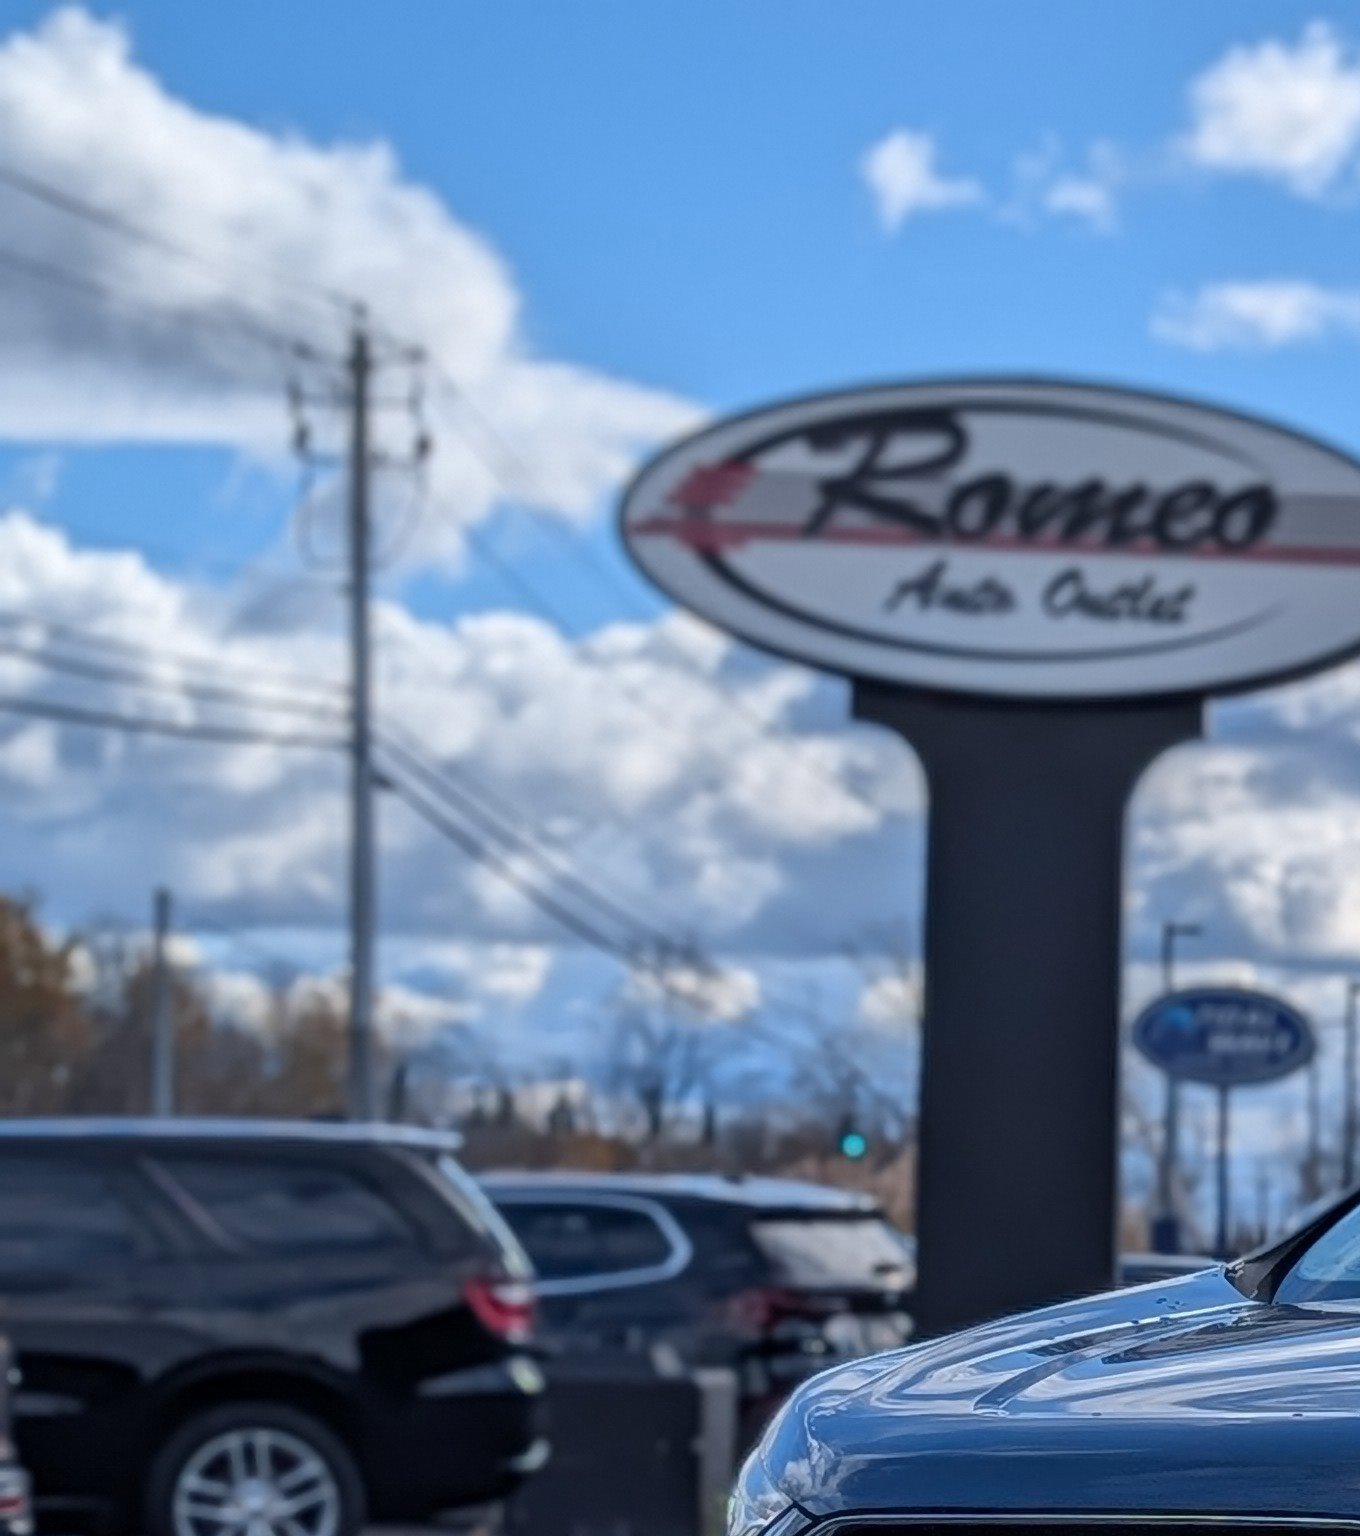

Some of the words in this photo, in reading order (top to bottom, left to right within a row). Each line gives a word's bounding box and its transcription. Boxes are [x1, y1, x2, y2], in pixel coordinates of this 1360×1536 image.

[800, 409, 1281, 551] Romeo
[884, 558, 1017, 618] Auto
[1041, 565, 1196, 624] Outlet
